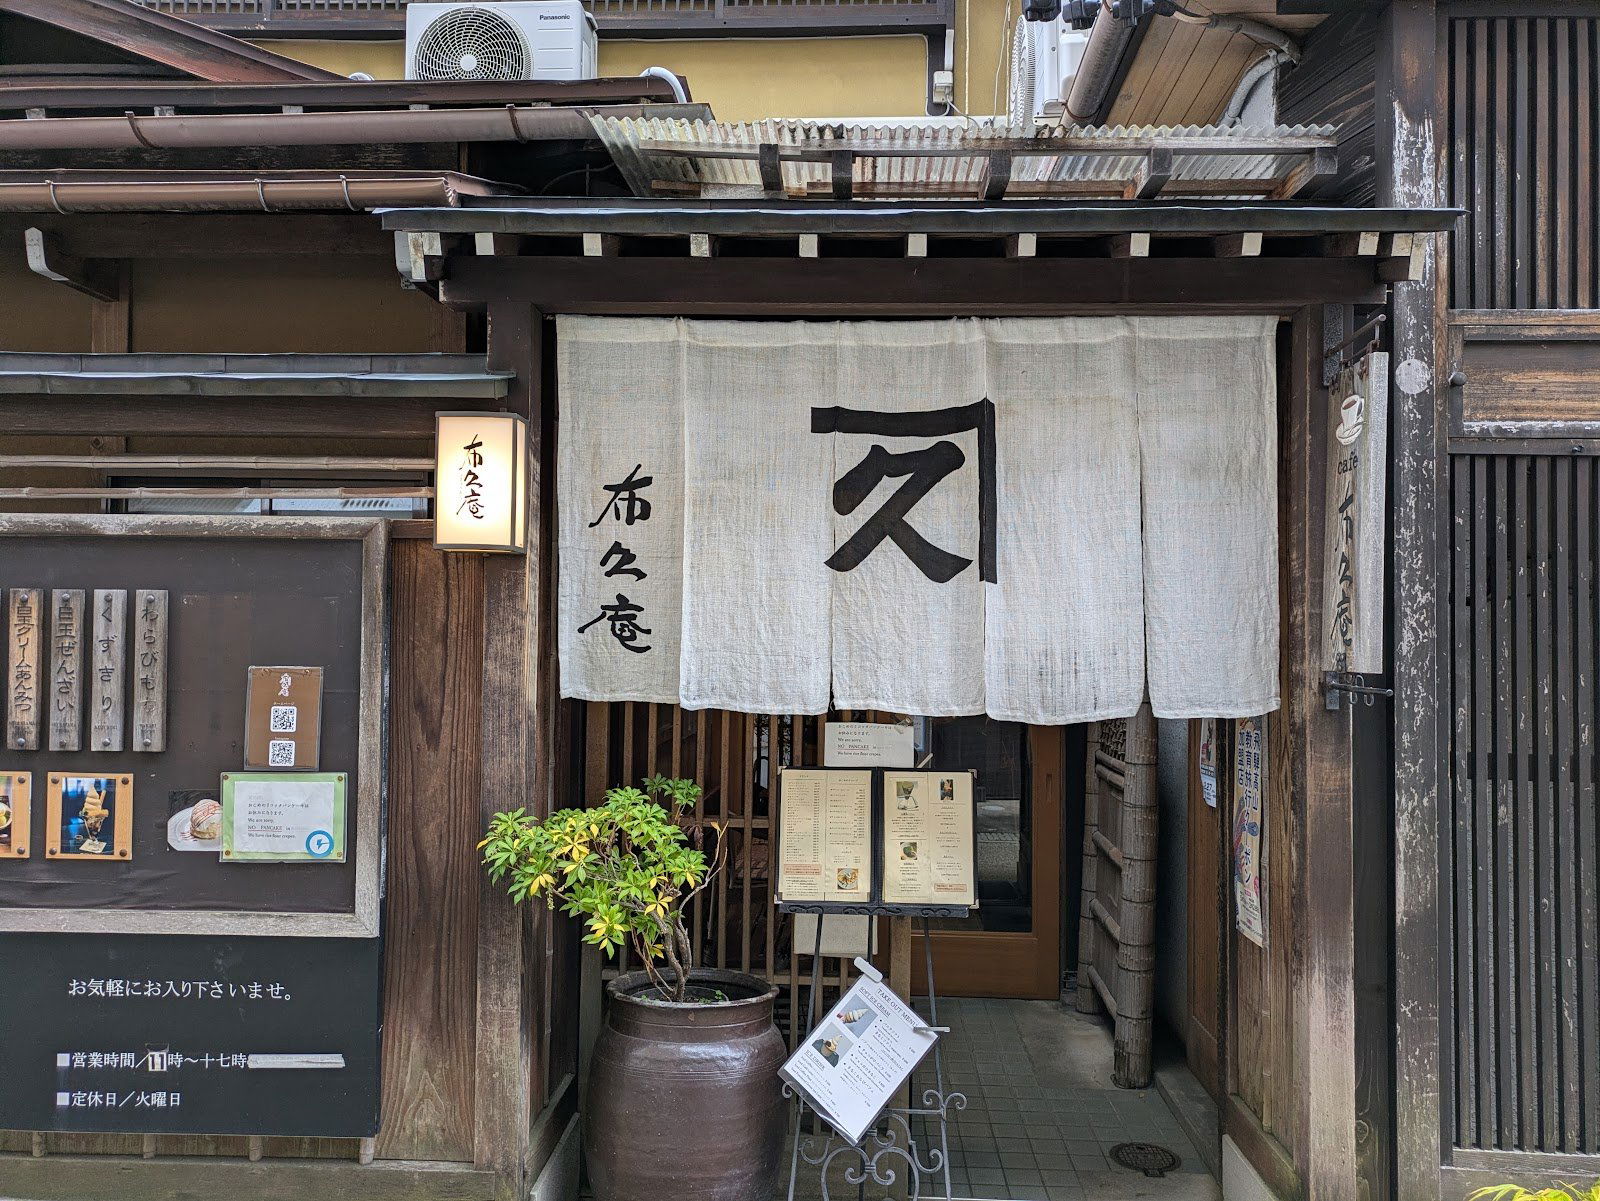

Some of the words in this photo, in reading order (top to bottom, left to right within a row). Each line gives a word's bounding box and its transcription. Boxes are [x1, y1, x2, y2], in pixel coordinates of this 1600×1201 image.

[539, 14, 571, 22] Panasonic
[456, 433, 485, 519] 布久庵
[577, 463, 653, 654] 布久庵
[14, 604, 35, 712] 白玉クリームあんみつ
[55, 603, 77, 712] 白玉ぜんざい
[98, 606, 118, 713] くずきり
[139, 605, 159, 713] わらびもち
[68, 978, 292, 1001] お気軽にお入り下さいませ。
[877, 988, 892, 1003] TAKE
[890, 1001, 904, 1014] OUT
